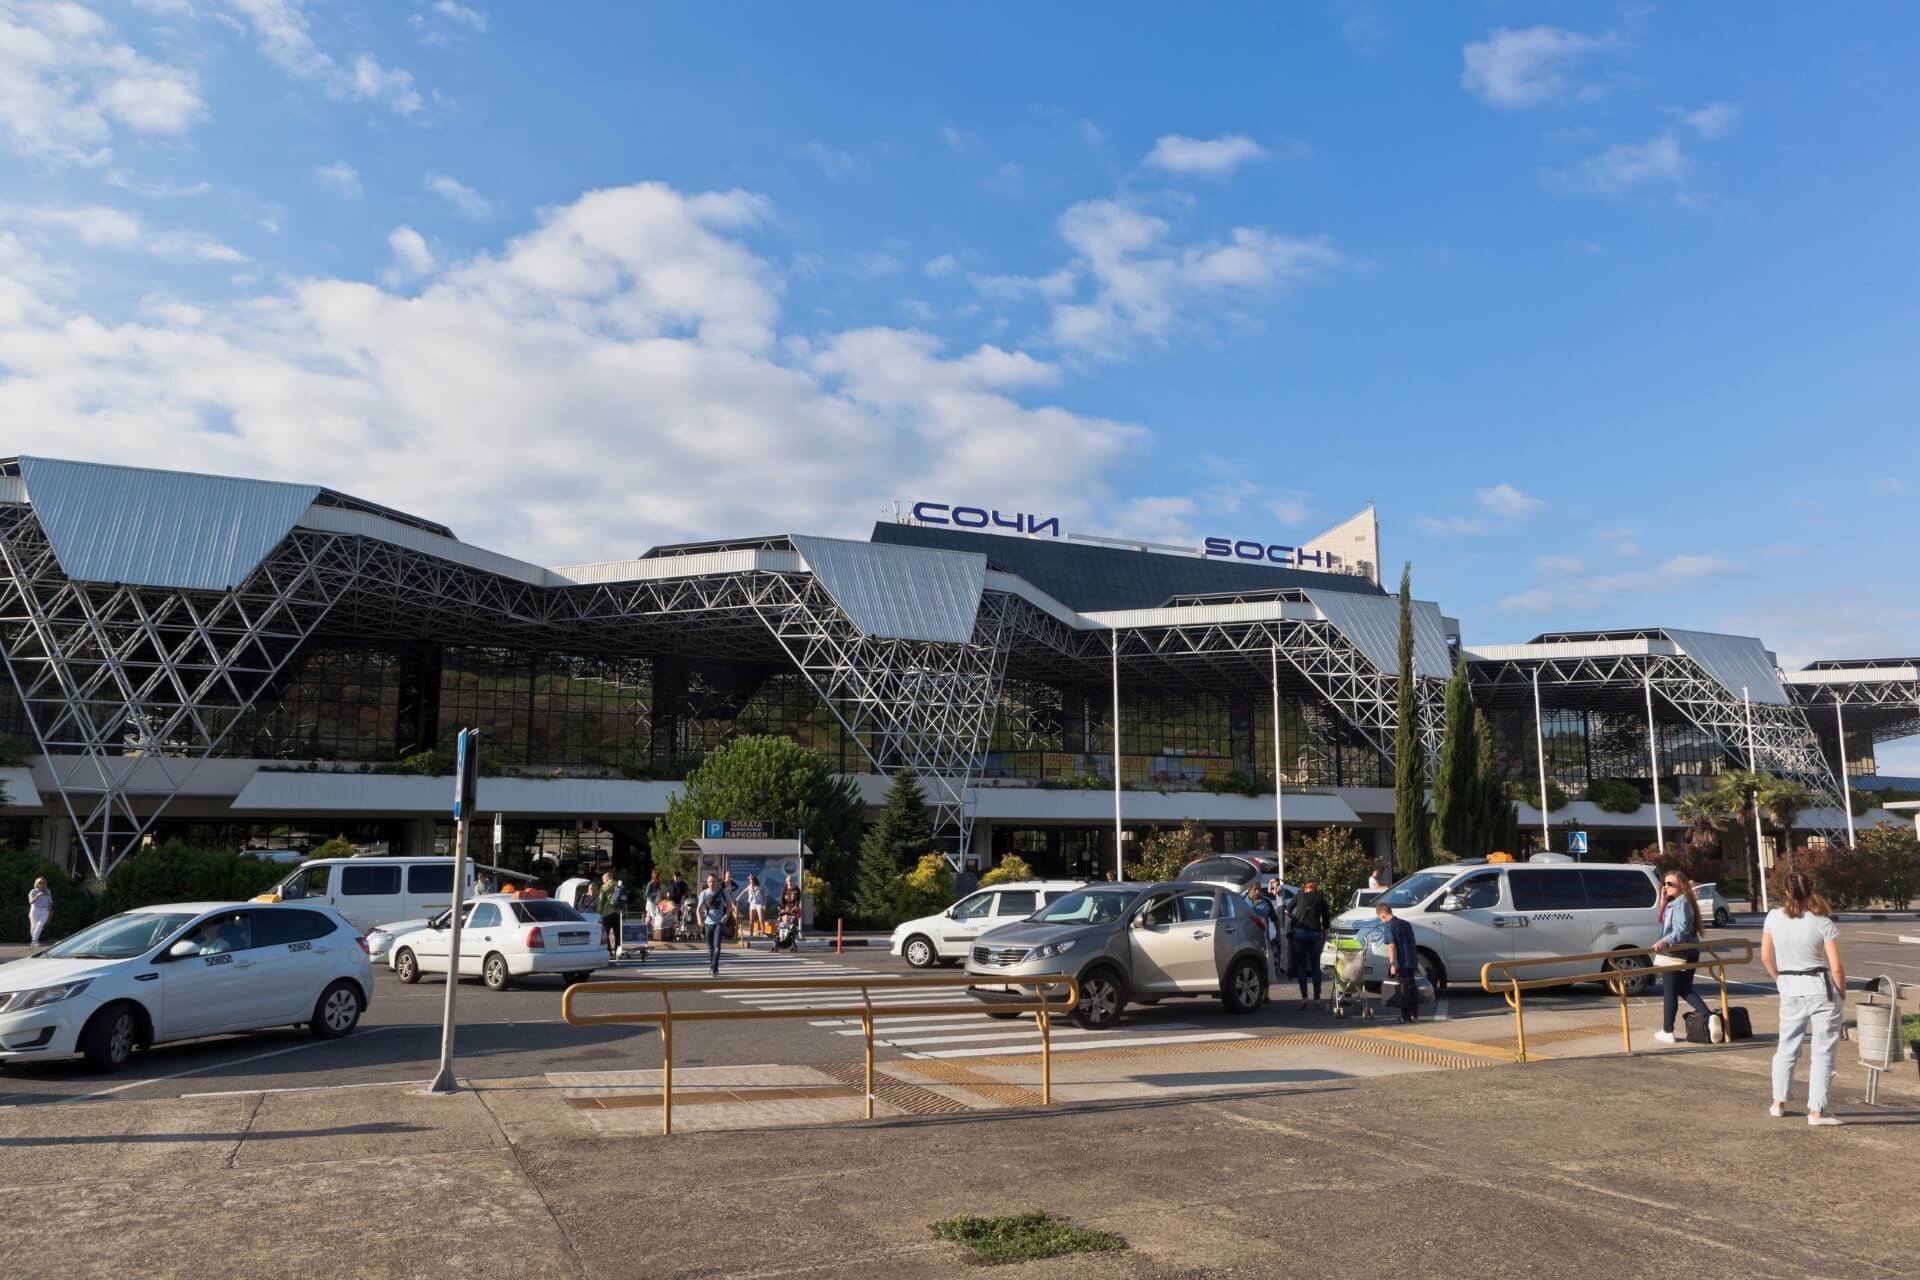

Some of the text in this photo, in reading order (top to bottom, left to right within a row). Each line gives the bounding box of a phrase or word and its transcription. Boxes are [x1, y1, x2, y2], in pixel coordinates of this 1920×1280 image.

[913, 502, 1058, 536] СОЧИ
[1204, 537, 1332, 568] SOCHI
[711, 824, 720, 836] P
